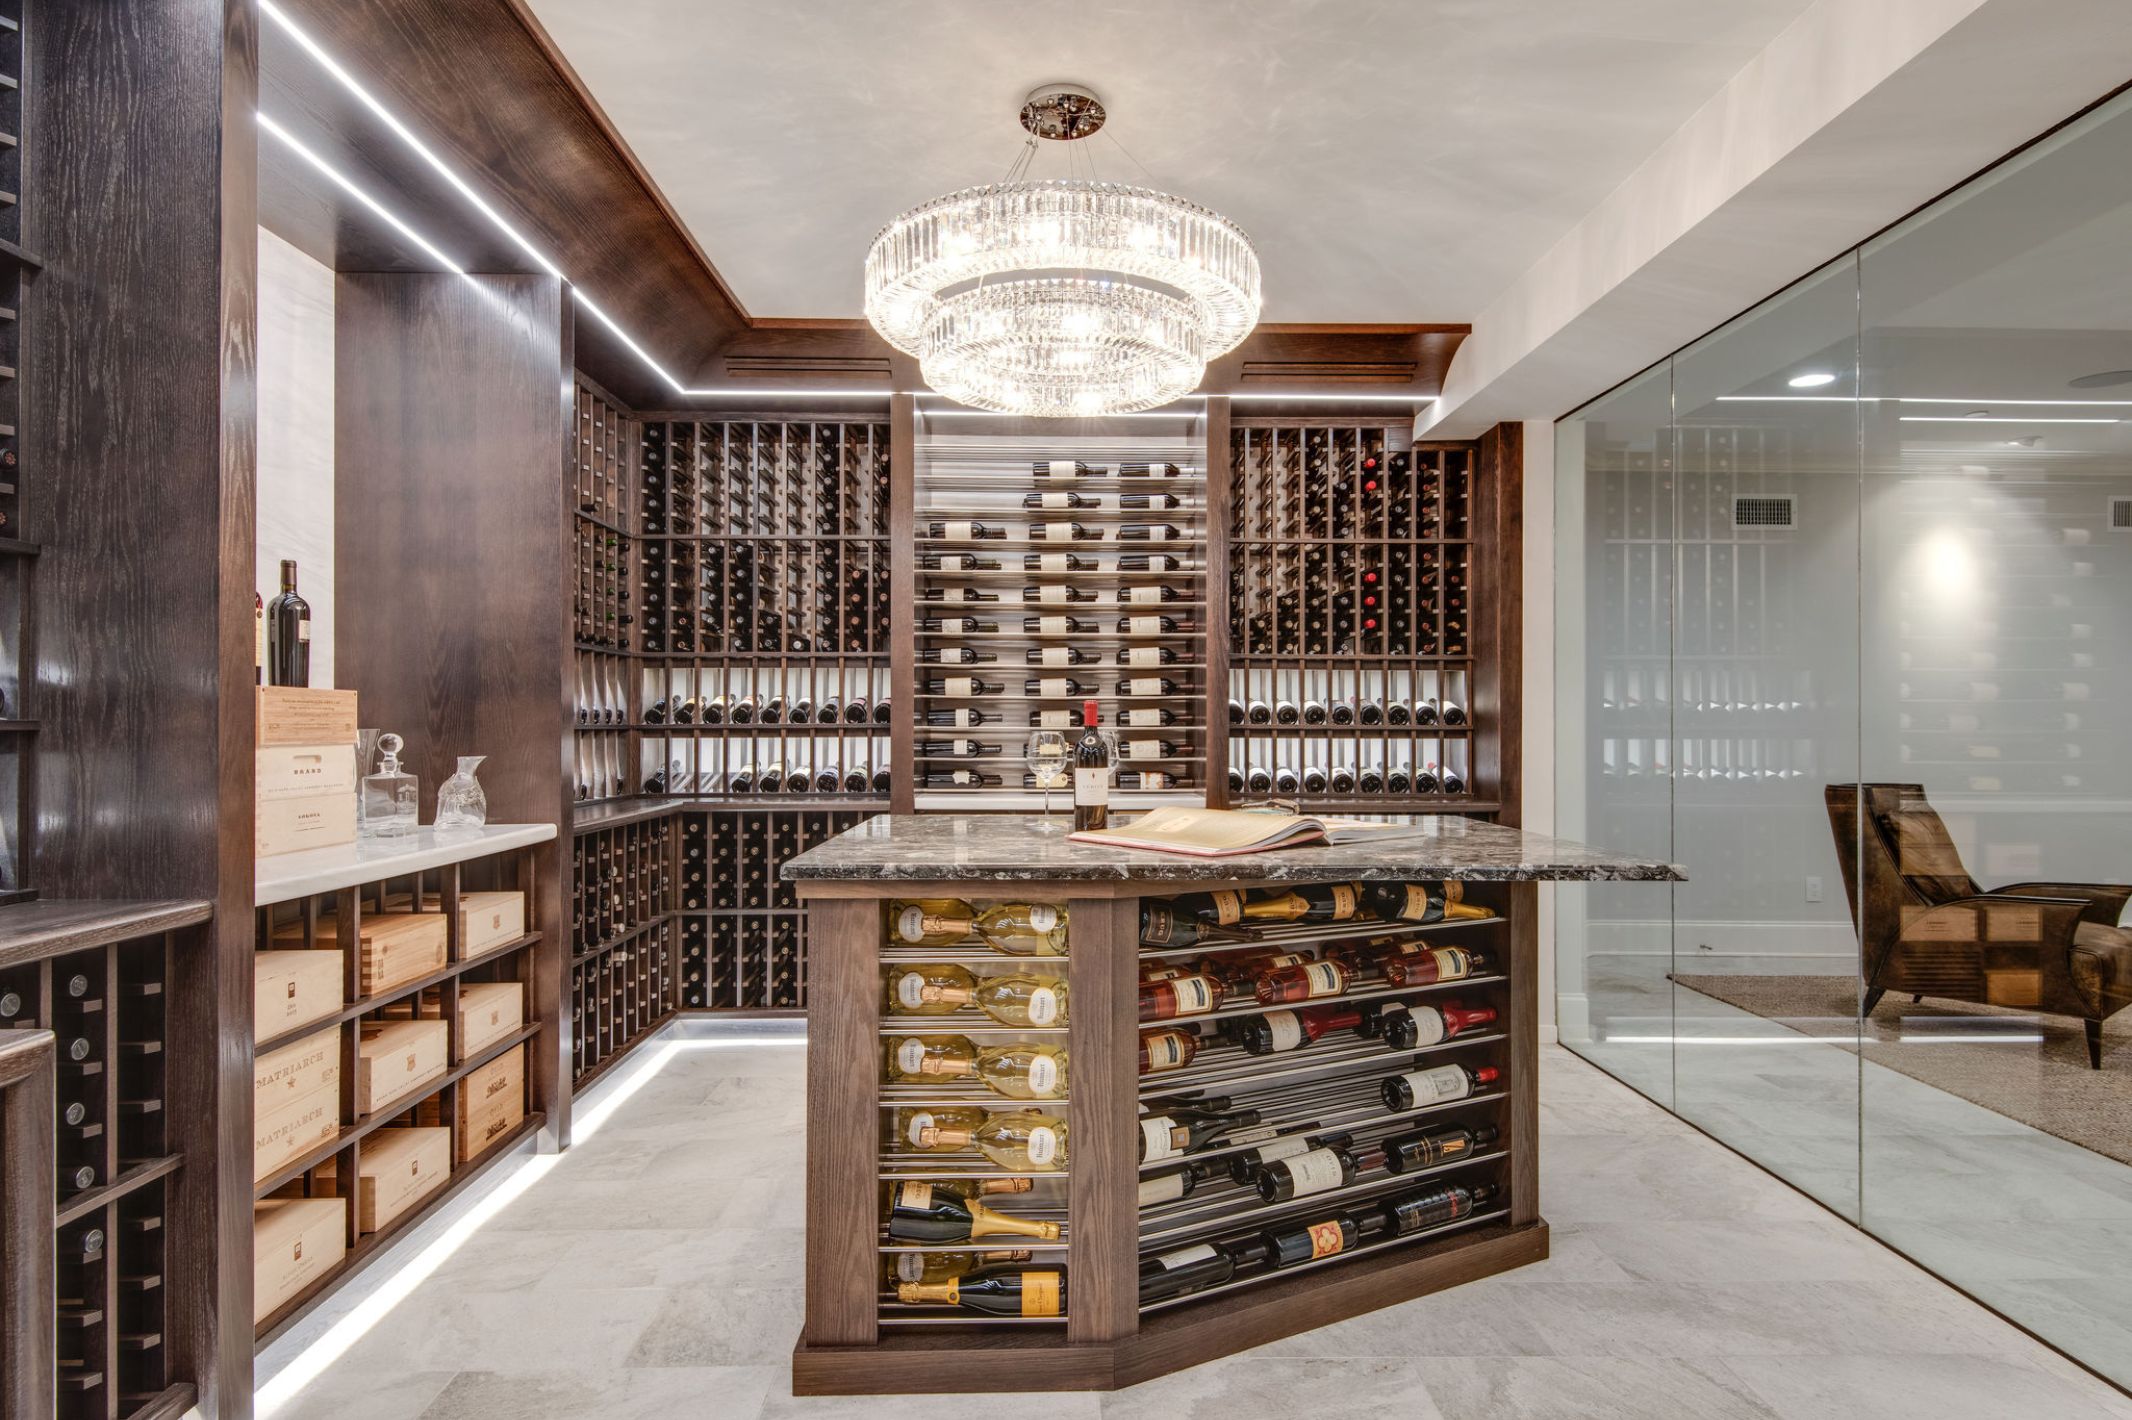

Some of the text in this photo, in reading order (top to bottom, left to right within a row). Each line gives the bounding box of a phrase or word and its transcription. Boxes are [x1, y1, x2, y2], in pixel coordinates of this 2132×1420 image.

[1158, 911, 1166, 936] KRUG
[256, 1051, 324, 1089] MATRIARCH
[256, 1107, 323, 1150] MATRIARCH
